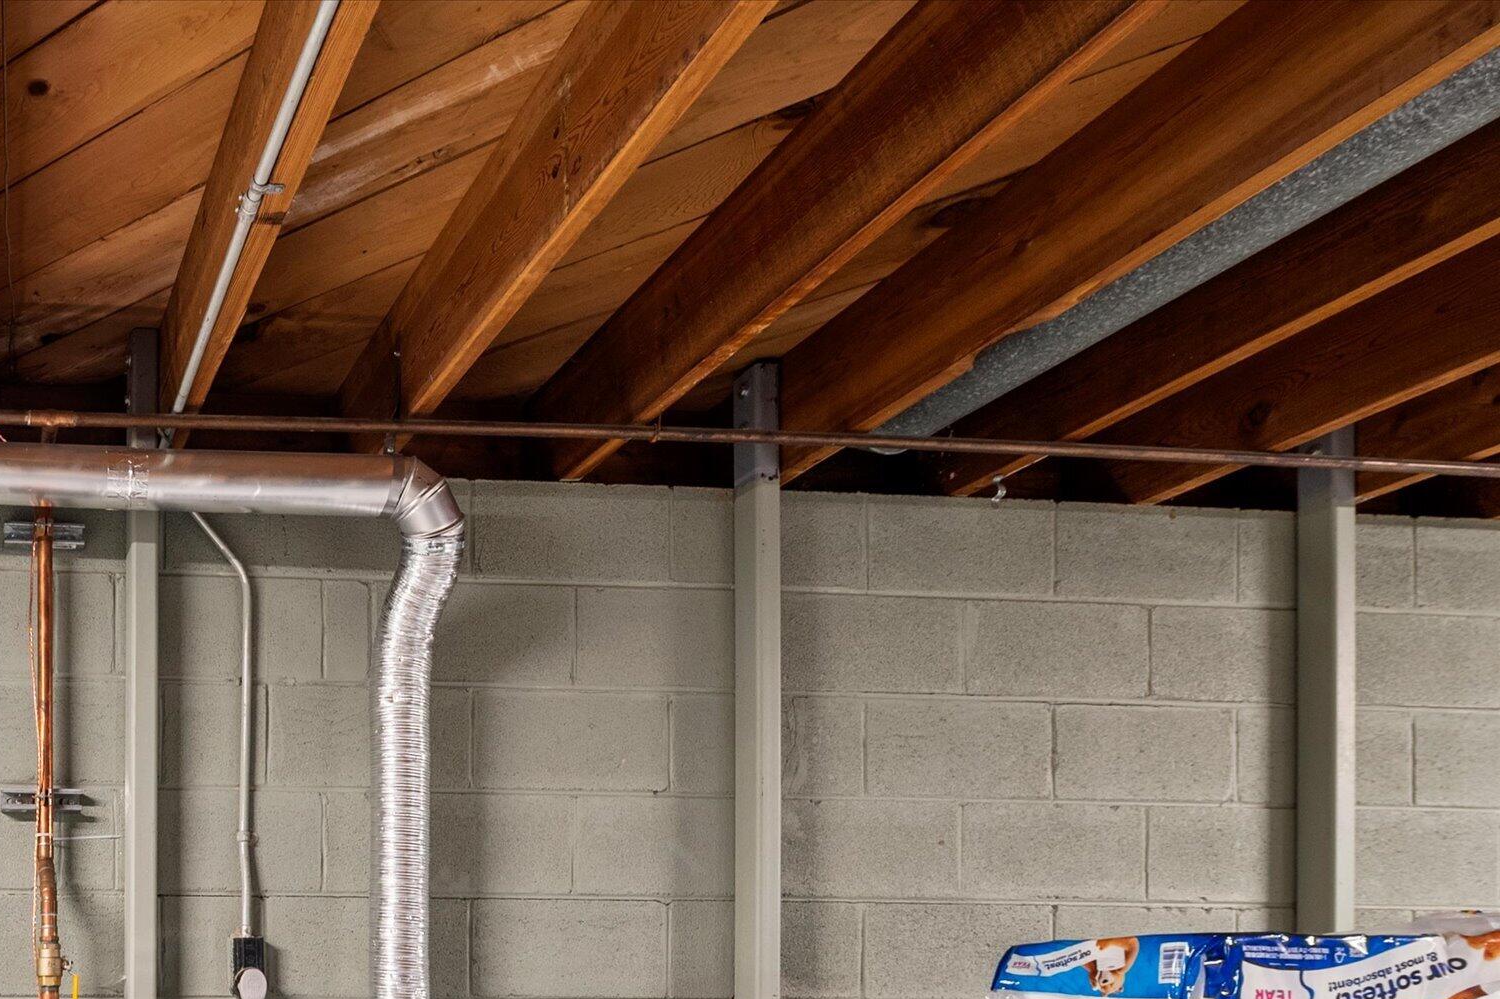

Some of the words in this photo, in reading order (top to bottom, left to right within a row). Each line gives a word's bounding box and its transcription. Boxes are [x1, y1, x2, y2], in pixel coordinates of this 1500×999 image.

[1396, 955, 1424, 972] most
[1426, 958, 1467, 980] our
[1328, 967, 1392, 992] absorbent!
